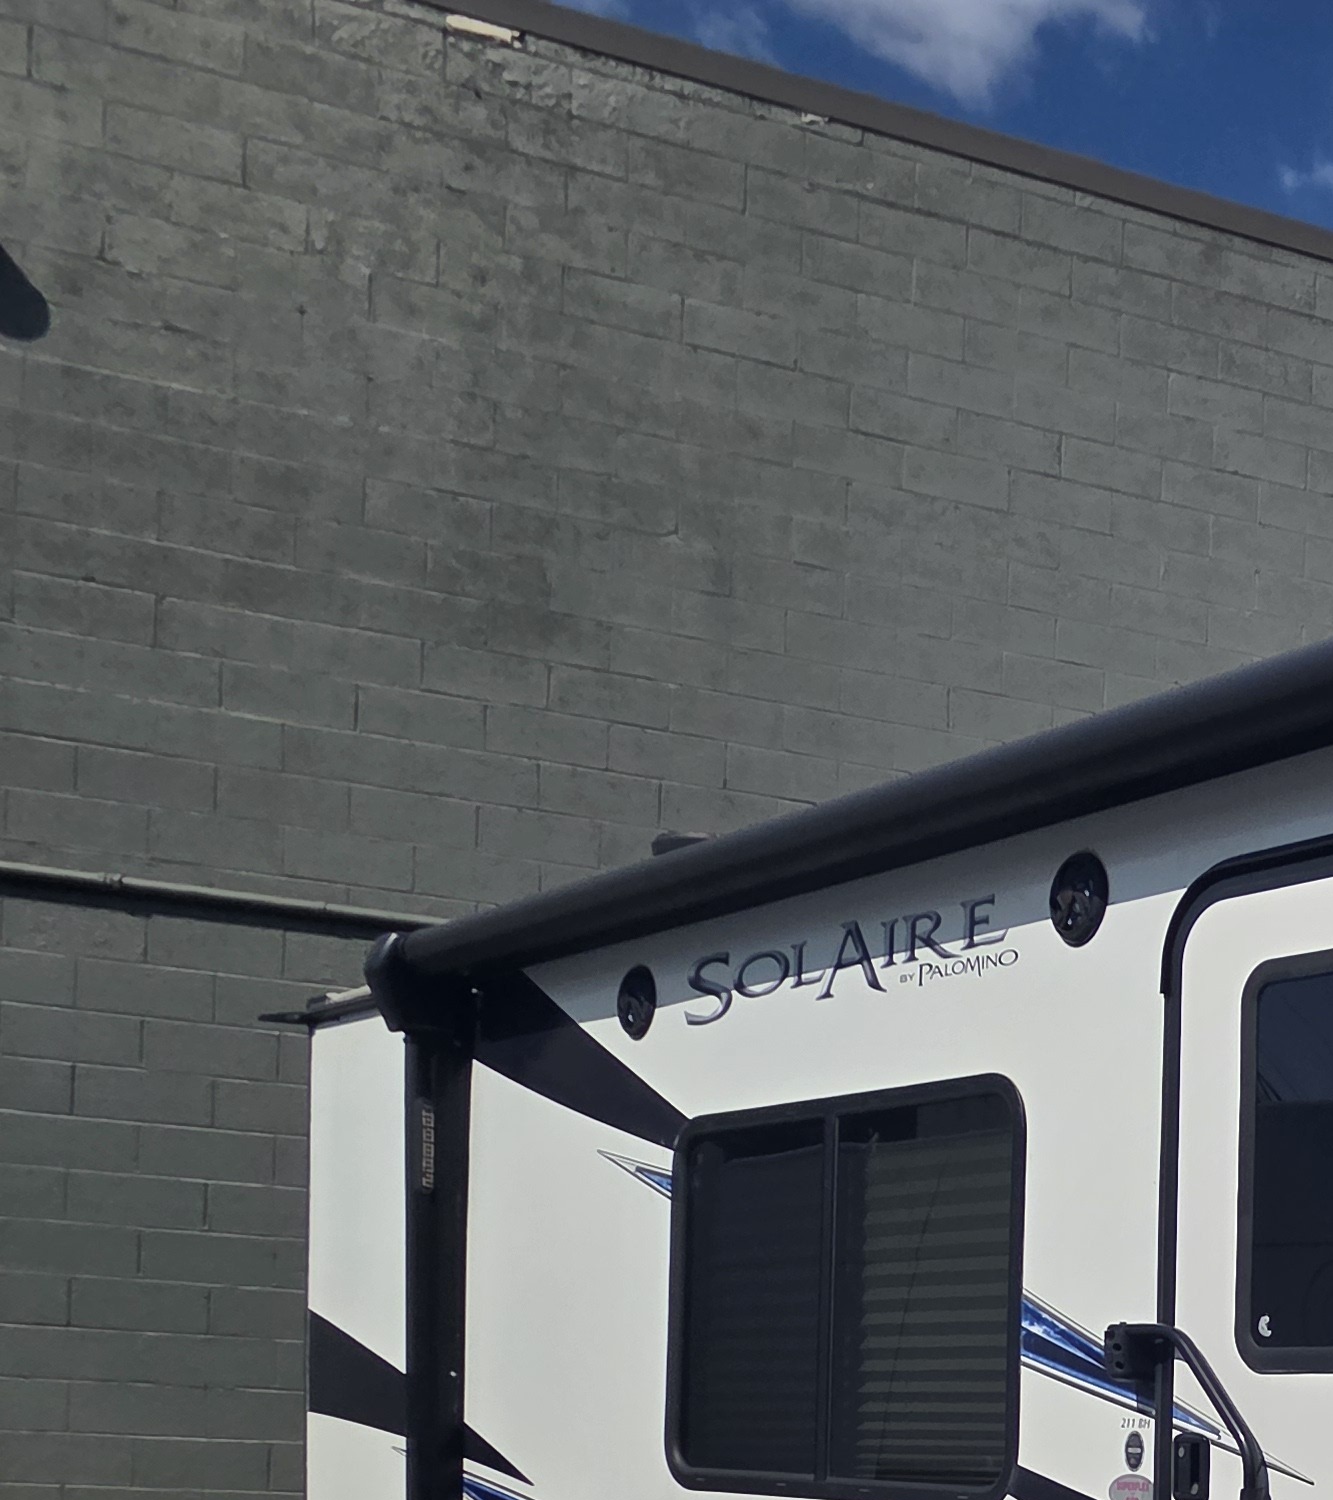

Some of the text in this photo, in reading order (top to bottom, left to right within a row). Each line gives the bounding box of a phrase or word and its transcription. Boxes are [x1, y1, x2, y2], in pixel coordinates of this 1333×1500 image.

[684, 894, 1009, 1026] SOLAIRE
[899, 949, 1019, 986] BY PALOMINO
[1121, 1418, 1135, 1428] 211
